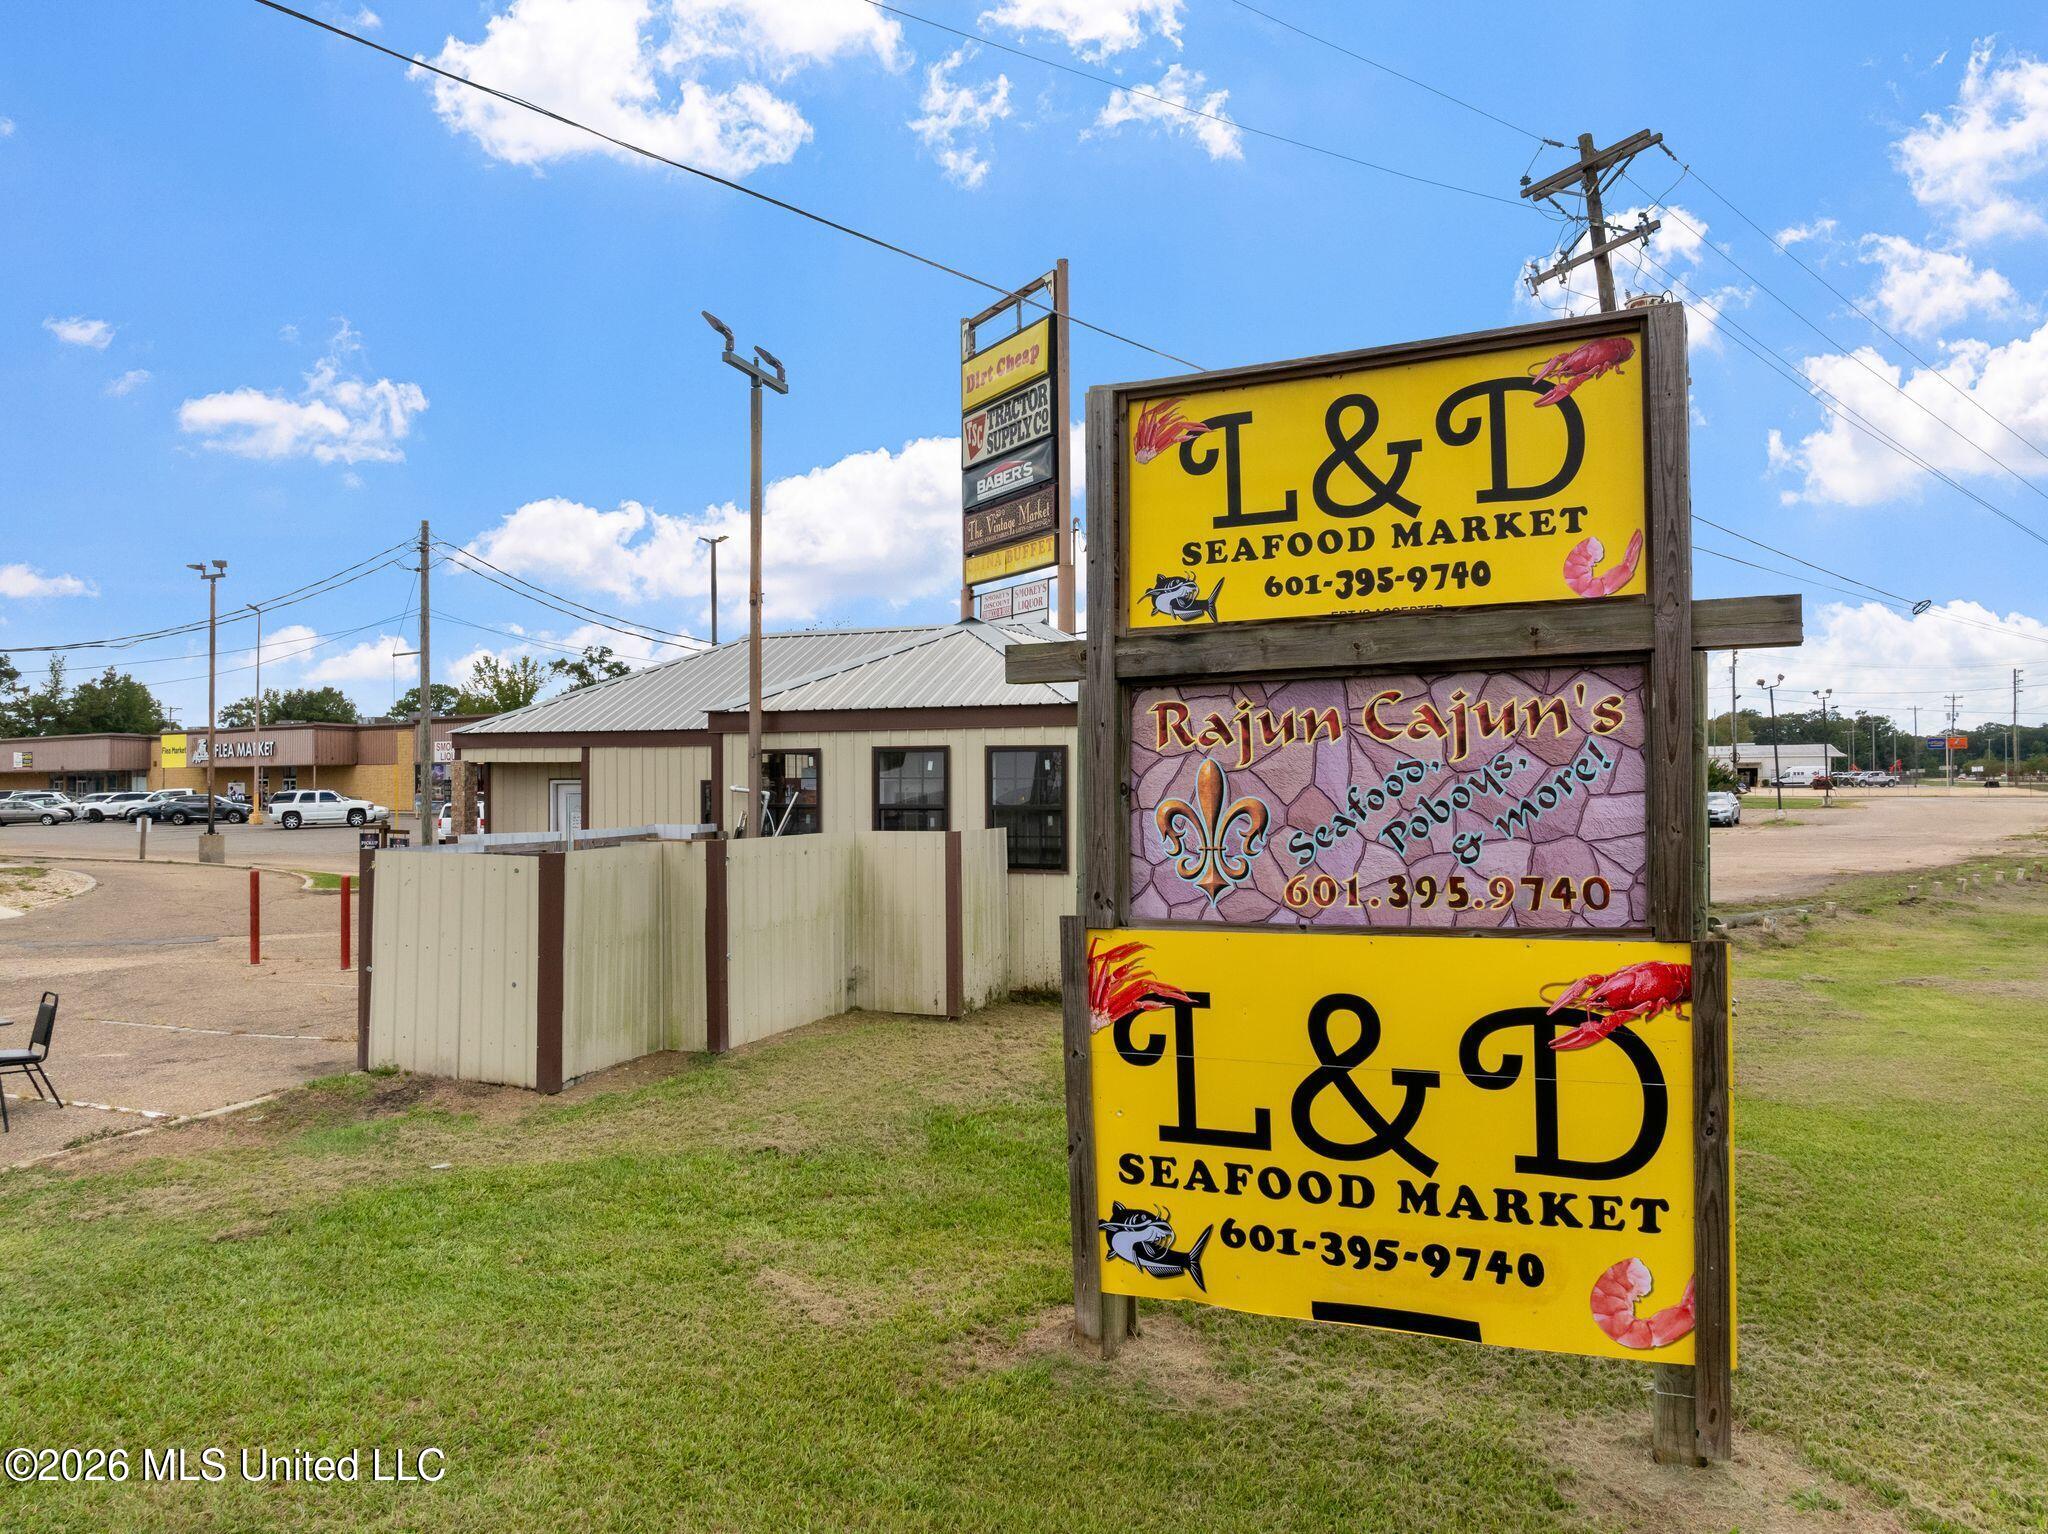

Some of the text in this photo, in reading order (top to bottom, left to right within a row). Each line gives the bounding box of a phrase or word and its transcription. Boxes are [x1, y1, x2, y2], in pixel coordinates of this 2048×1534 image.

[966, 343, 1040, 394] Dirt Cheap
[987, 383, 1048, 431] TRACTOR
[966, 421, 984, 449] TSC
[987, 415, 1033, 455] SUPPLY
[977, 461, 1033, 495] BABER'S
[968, 519, 983, 541] The
[986, 514, 1016, 535] Vintage
[1018, 498, 1050, 525] Market
[1181, 506, 1589, 567] SEAFOOD MARKET
[1005, 537, 1053, 563] BUFFET
[1014, 582, 1047, 599] SMOKEY'S
[1264, 560, 1492, 599] 601-395-9740
[1017, 596, 1044, 610] LIQUOR
[1151, 681, 1625, 768] Rajun Cajun's
[162, 746, 187, 754] Flea Market
[214, 743, 235, 758] FLEA
[1450, 738, 1615, 868] & more!
[1283, 874, 1613, 912] 601.395.9740
[1117, 1152, 1671, 1235] SEAFOOD MARKET
[1219, 1217, 1547, 1289] 601-395-9740
